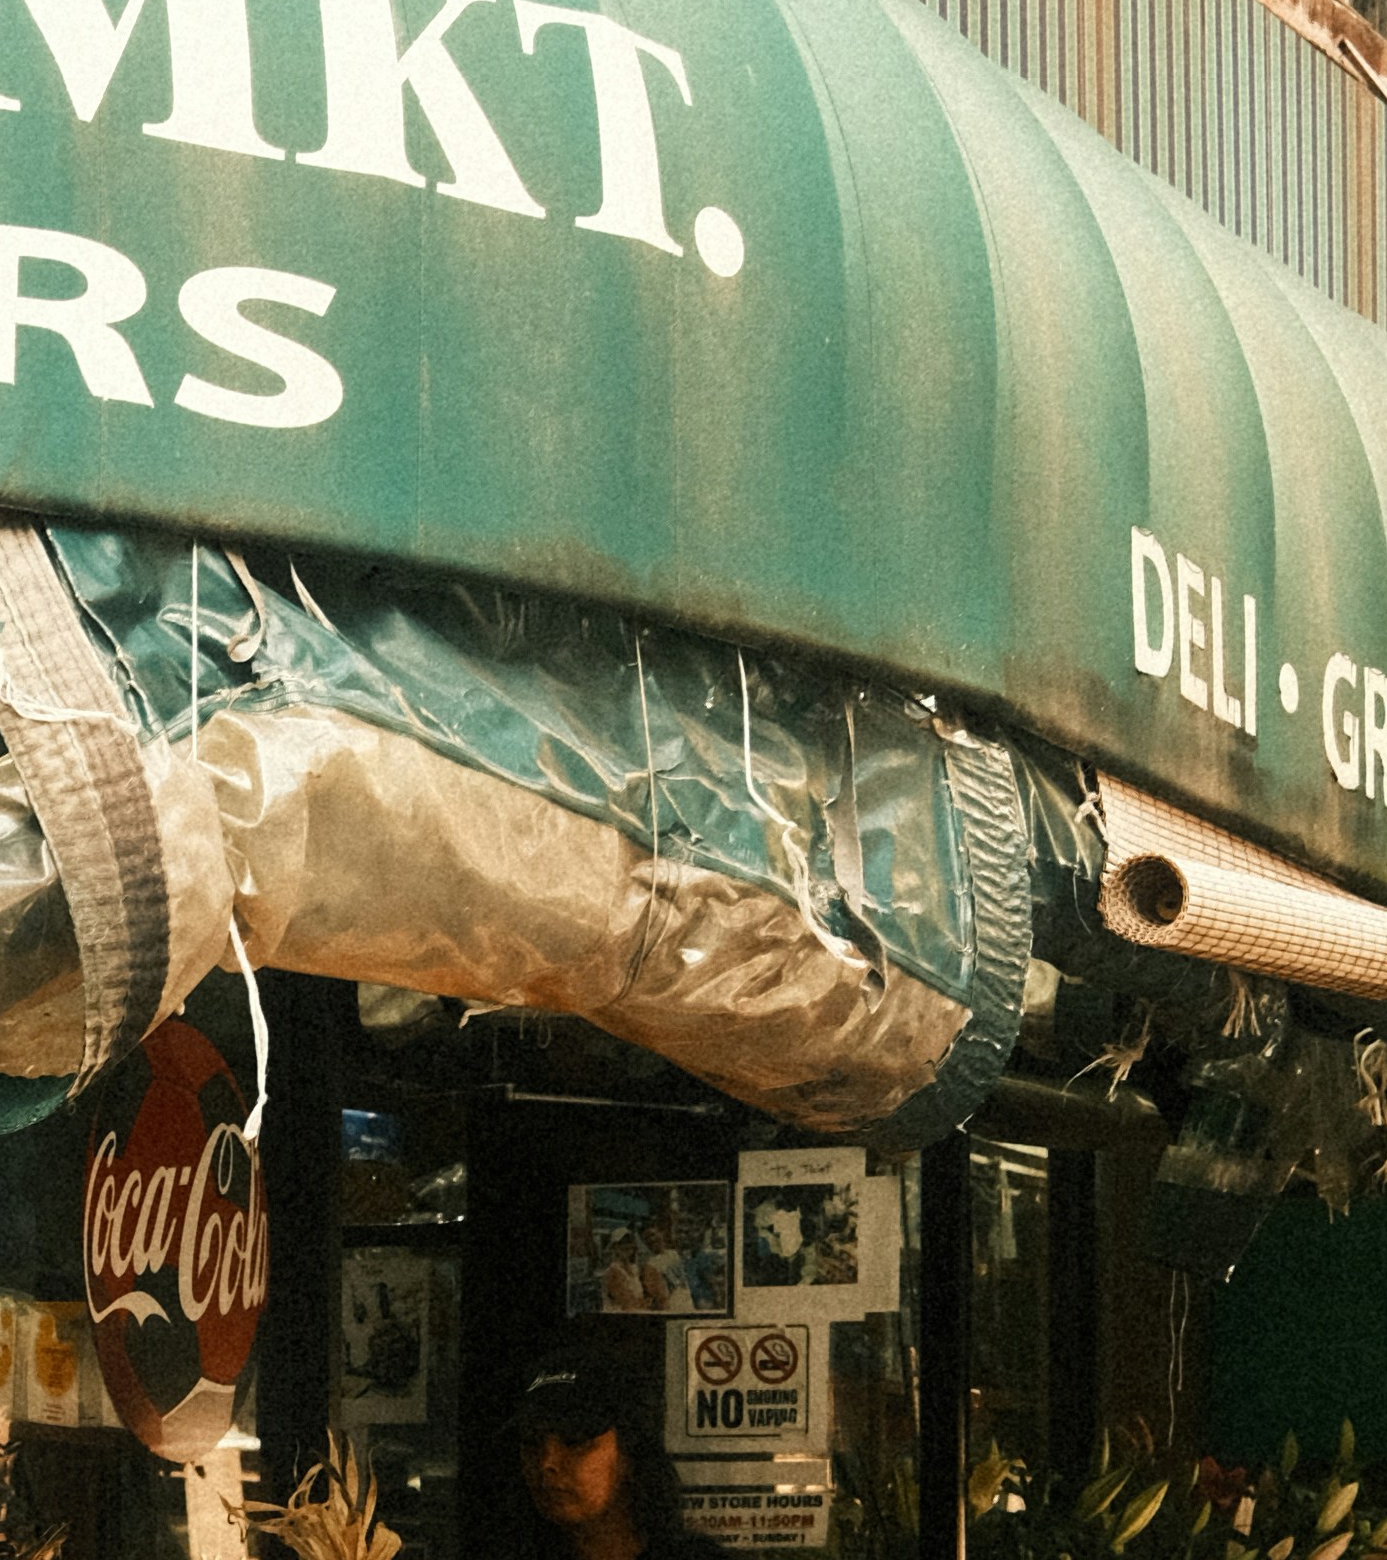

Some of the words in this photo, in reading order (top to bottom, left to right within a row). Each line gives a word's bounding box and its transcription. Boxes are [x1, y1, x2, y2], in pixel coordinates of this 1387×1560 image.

[1130, 525, 1257, 737] DELI
[83, 1122, 267, 1327] Coca-Cola
[697, 1389, 744, 1429] NO
[746, 1389, 798, 1405] SMOKING
[748, 1408, 797, 1428] VAPING
[709, 1496, 762, 1509] STORE
[767, 1495, 823, 1509] HOURS
